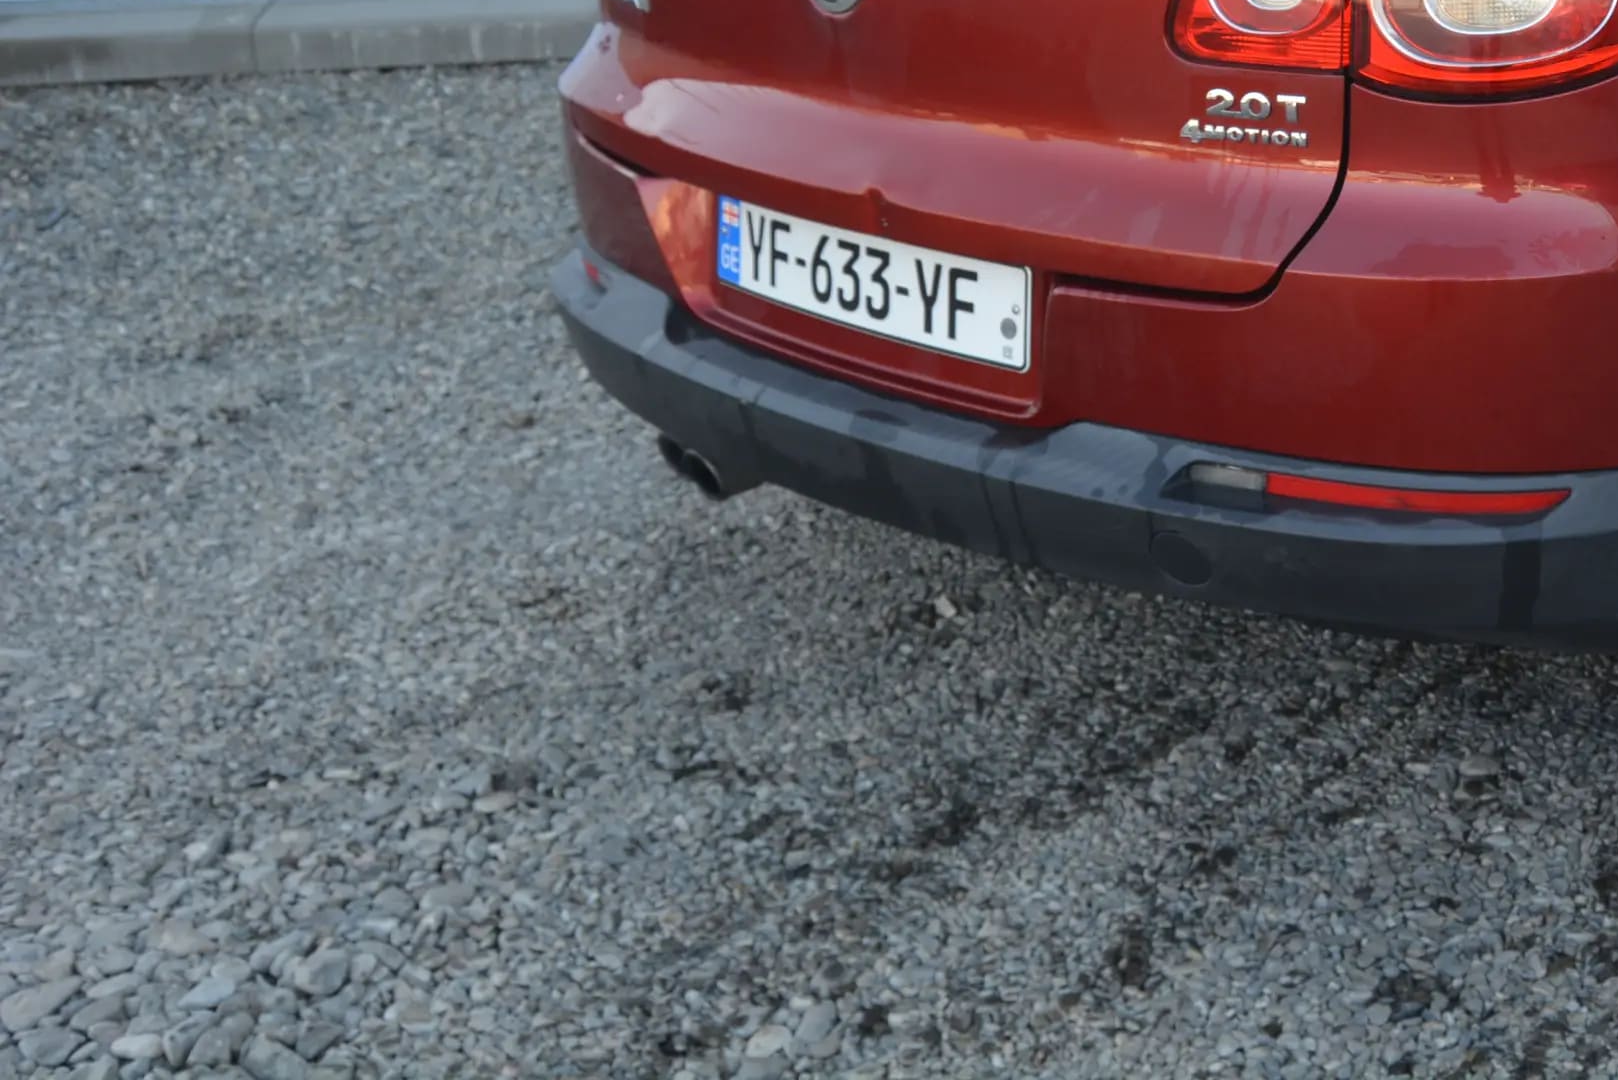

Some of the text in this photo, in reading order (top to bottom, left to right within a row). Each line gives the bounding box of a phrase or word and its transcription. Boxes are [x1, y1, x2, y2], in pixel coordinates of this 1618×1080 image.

[1180, 118, 1309, 148] 4MOTION
[721, 243, 740, 273] GE
[746, 210, 979, 340] YF-633-YF
